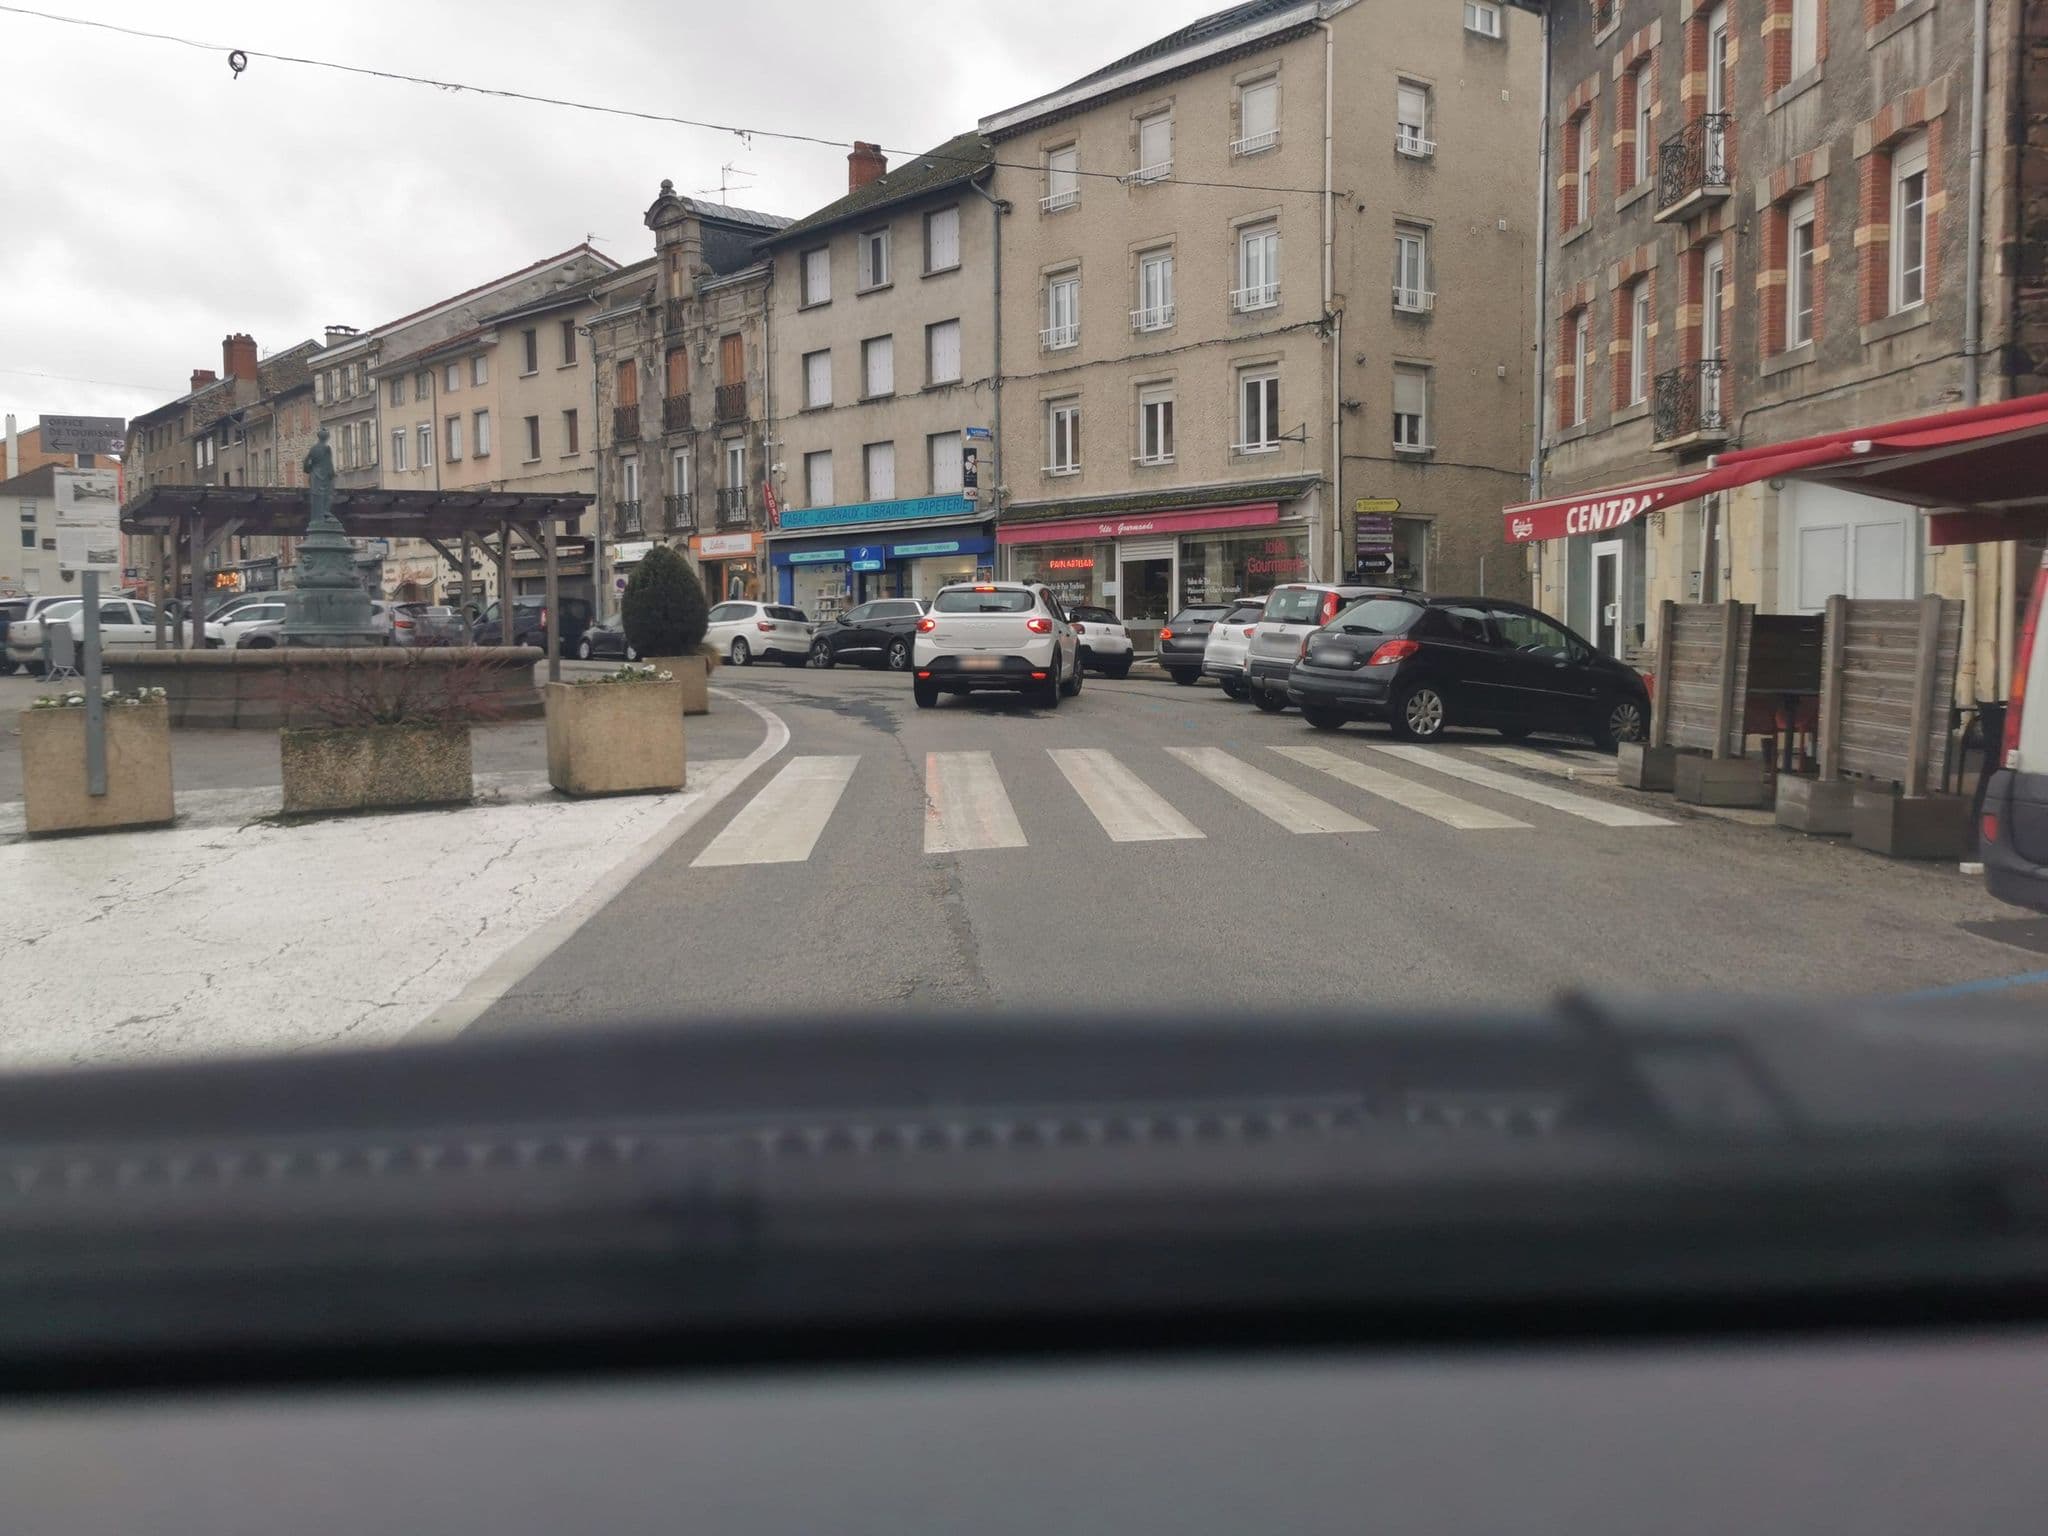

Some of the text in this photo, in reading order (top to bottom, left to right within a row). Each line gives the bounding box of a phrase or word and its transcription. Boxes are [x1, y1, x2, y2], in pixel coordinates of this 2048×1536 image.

[47, 418, 83, 427] OFFICE
[48, 427, 121, 438] DE TOURISME
[764, 482, 779, 525] TABAC
[782, 497, 969, 524] TABAC JOURNAUX LIBRAIRIE PAPETERIE
[1049, 559, 1066, 569] PAIN
